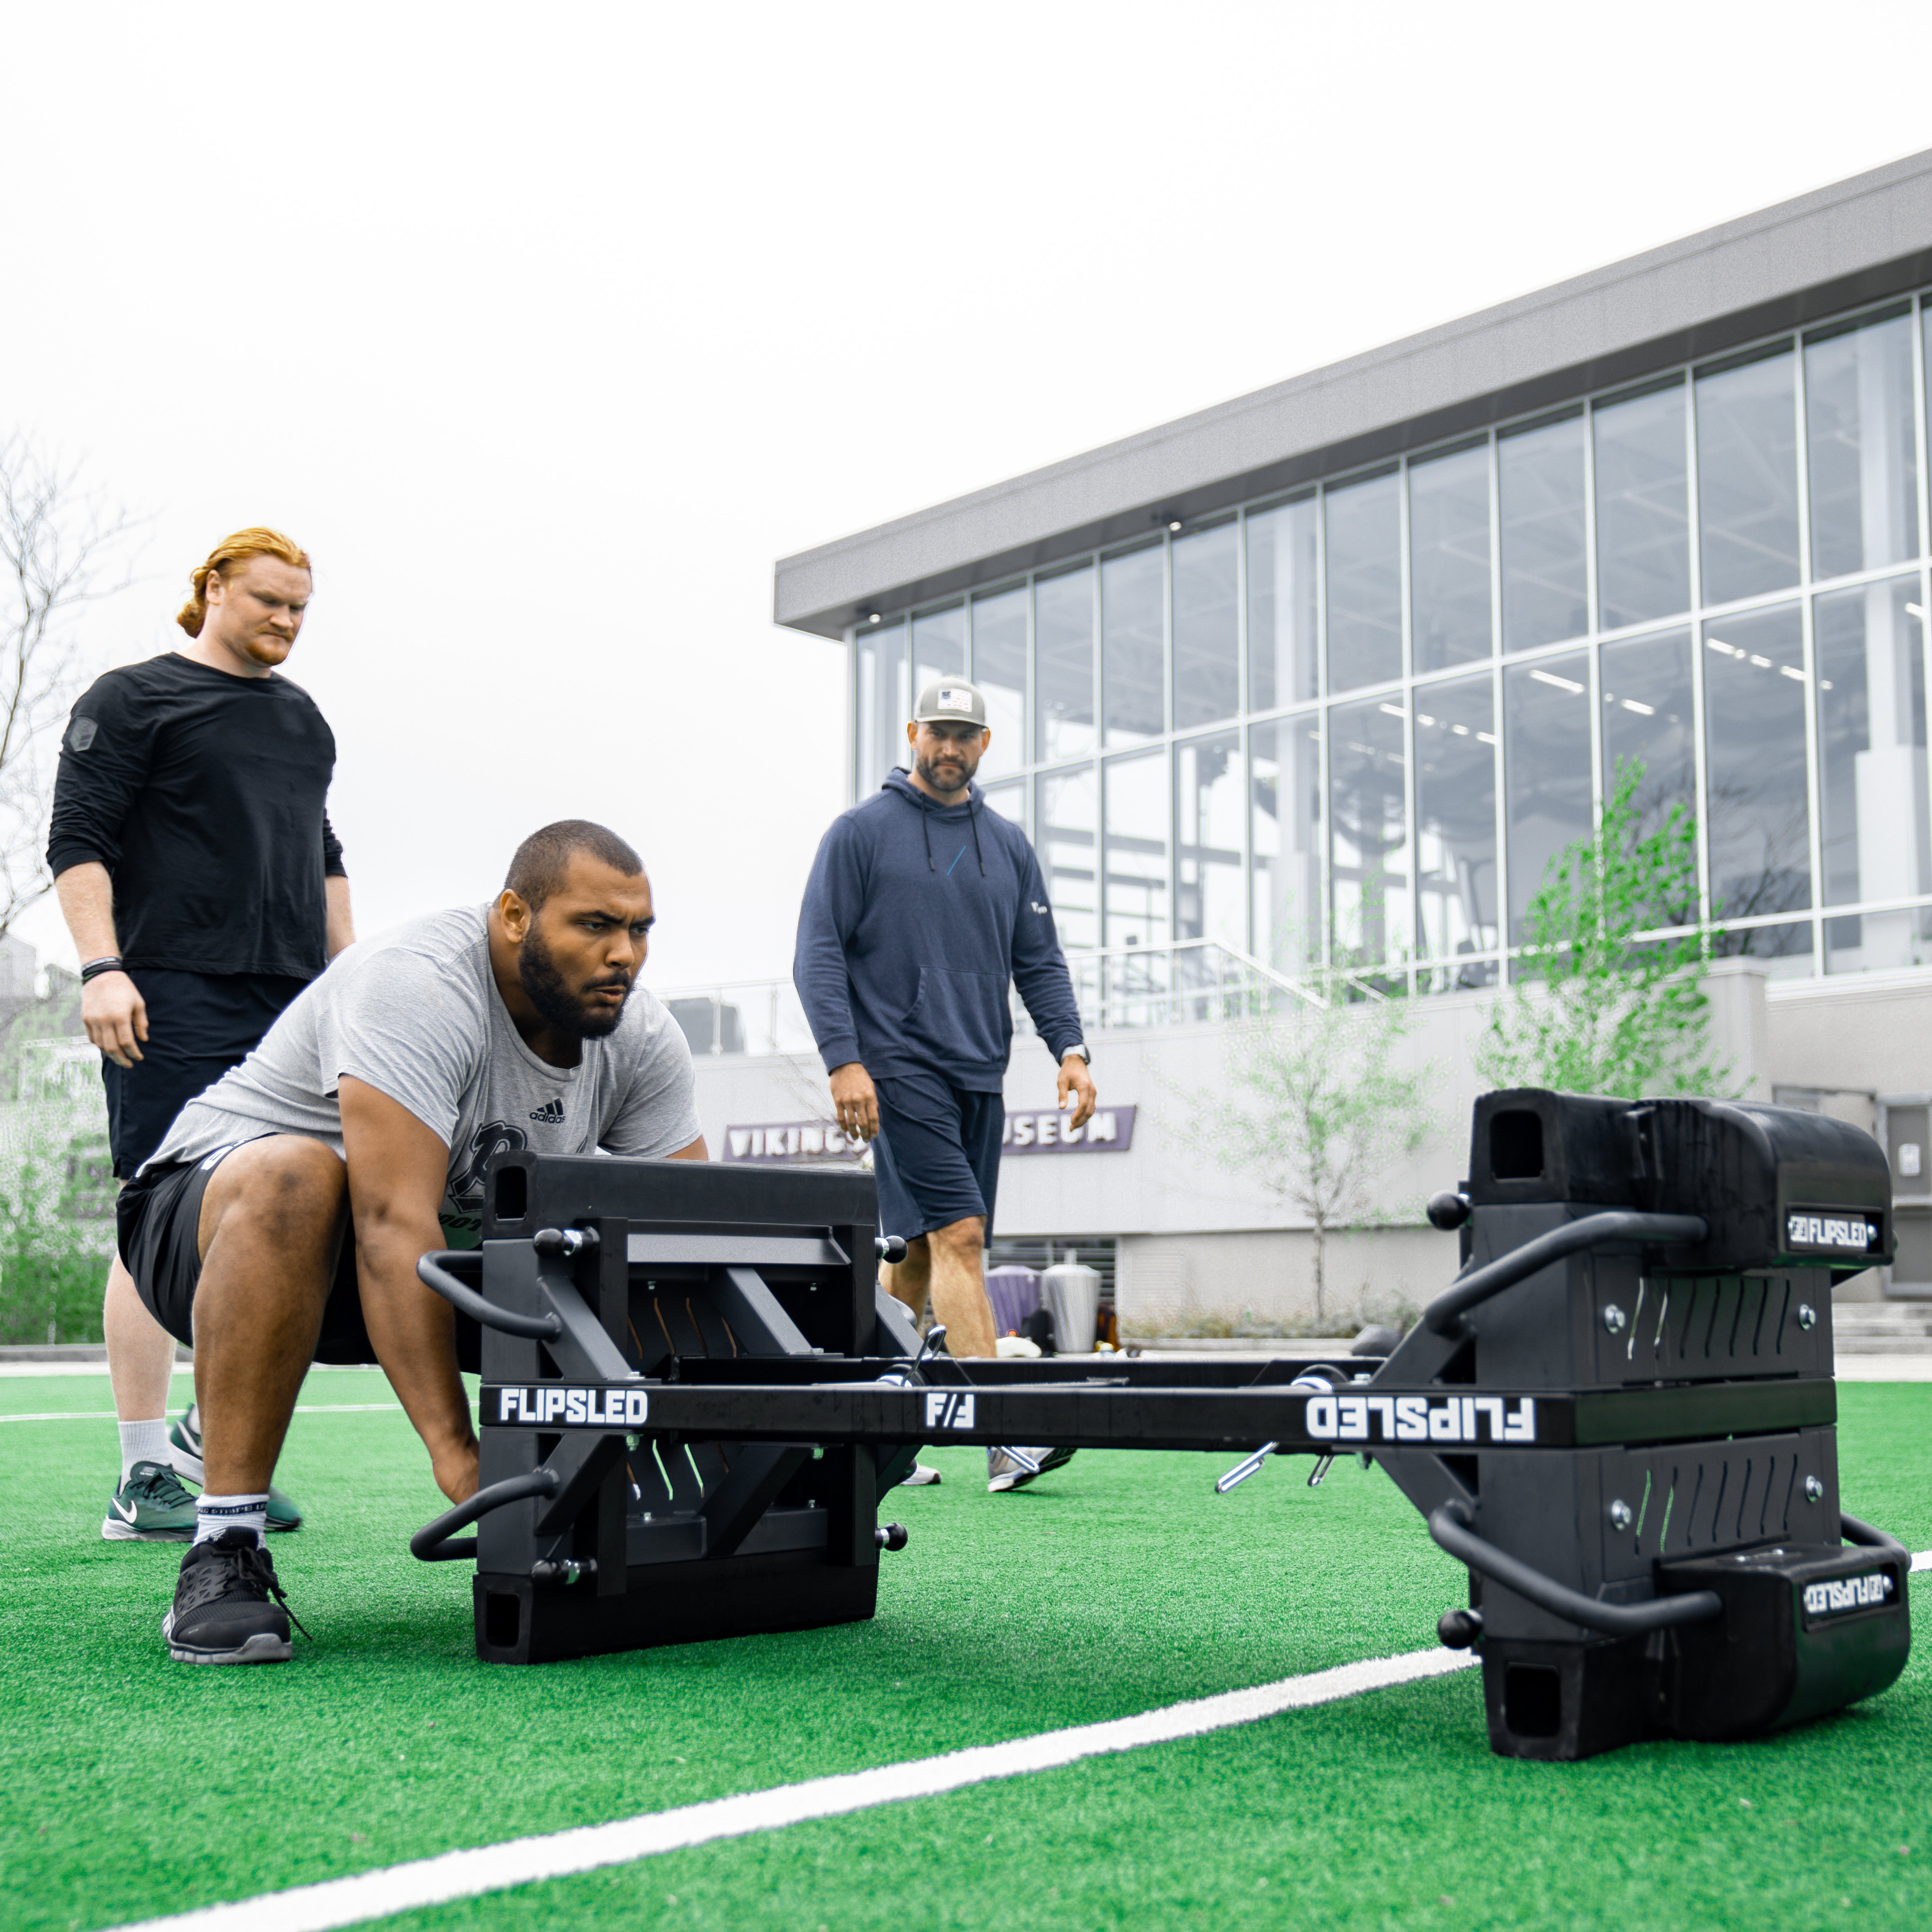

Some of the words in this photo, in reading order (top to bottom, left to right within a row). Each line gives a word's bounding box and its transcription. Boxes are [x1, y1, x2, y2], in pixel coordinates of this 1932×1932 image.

[530, 1112, 566, 1124] adidas
[1809, 1217, 1867, 1248] FLIPSLED
[500, 1388, 648, 1424] FLIPSLED
[1306, 1397, 1535, 1441] FLIPSLED
[1805, 1576, 1869, 1614] FLIPSLED
